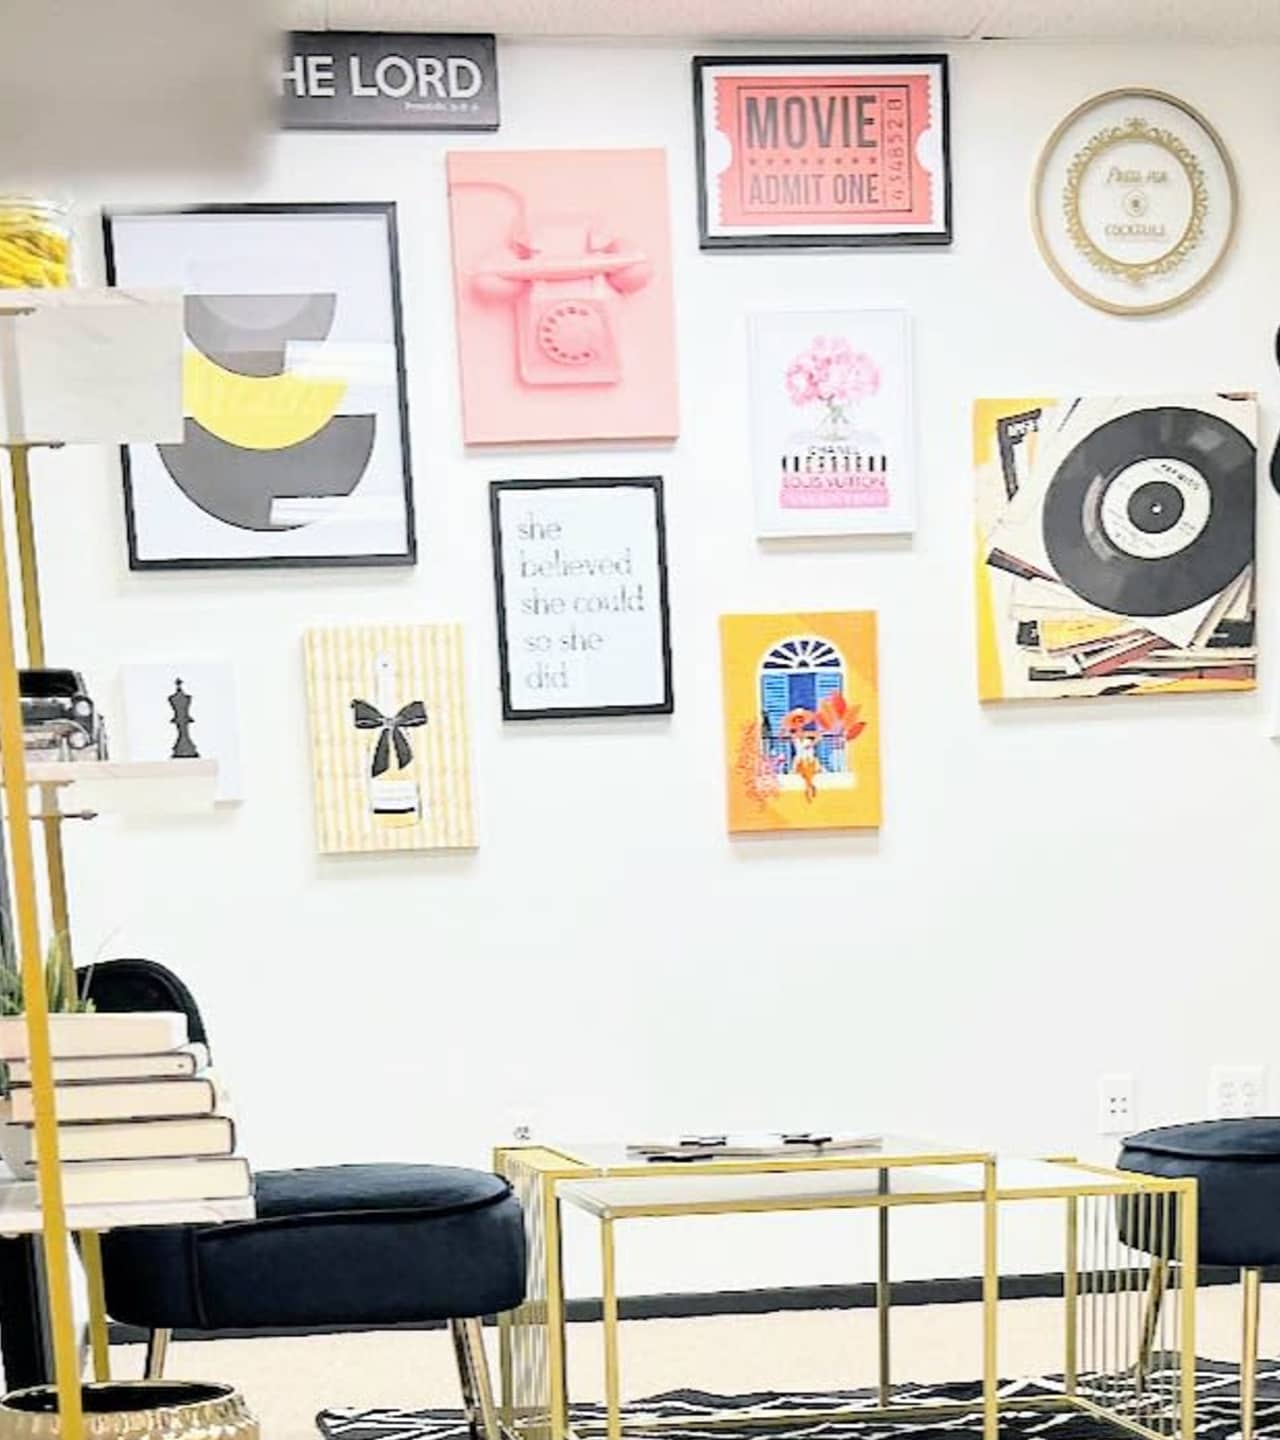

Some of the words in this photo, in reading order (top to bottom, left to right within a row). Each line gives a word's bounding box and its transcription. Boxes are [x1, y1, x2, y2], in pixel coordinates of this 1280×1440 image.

[281, 55, 336, 97] HE
[350, 55, 482, 98] LORD
[745, 95, 878, 149] MOVIE
[749, 174, 824, 205] ADMIT
[833, 173, 879, 205] ONE
[518, 511, 562, 540] she
[521, 547, 632, 578] believed
[521, 586, 566, 615] she
[573, 583, 645, 612] could
[524, 633, 552, 652] so
[560, 622, 604, 651] she
[526, 660, 569, 689] did
